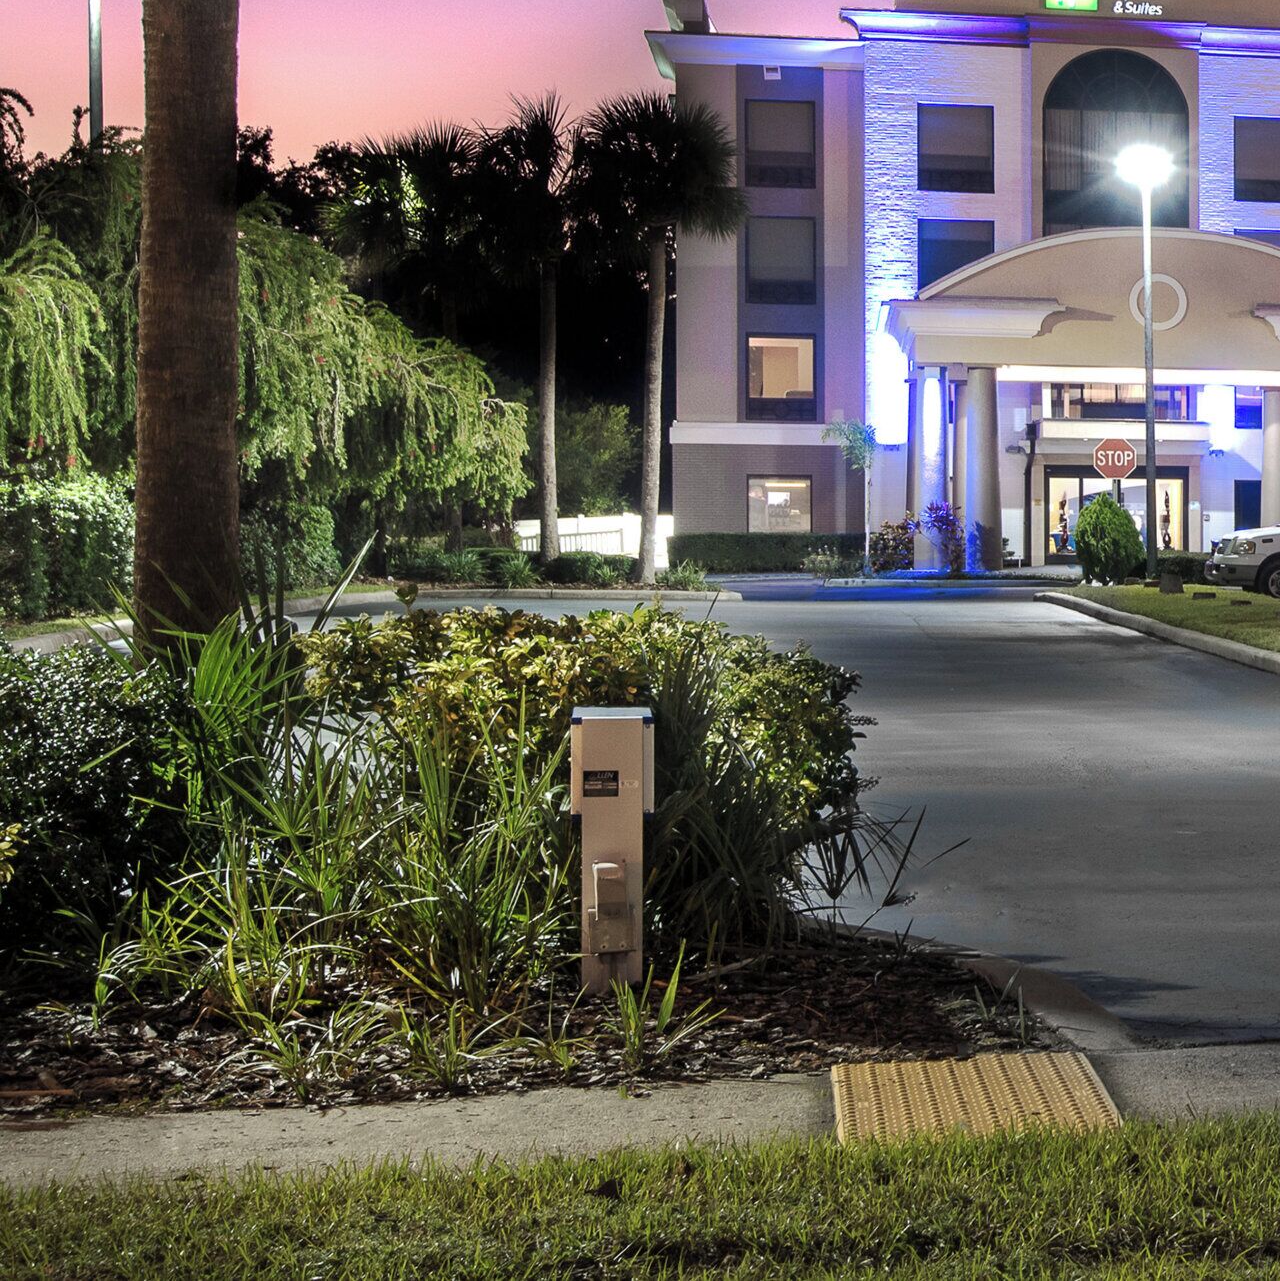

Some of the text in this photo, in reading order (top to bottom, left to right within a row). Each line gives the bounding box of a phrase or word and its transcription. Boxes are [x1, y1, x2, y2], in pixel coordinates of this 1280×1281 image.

[1113, 0, 1163, 15] & Suites
[1097, 450, 1134, 466] STOP
